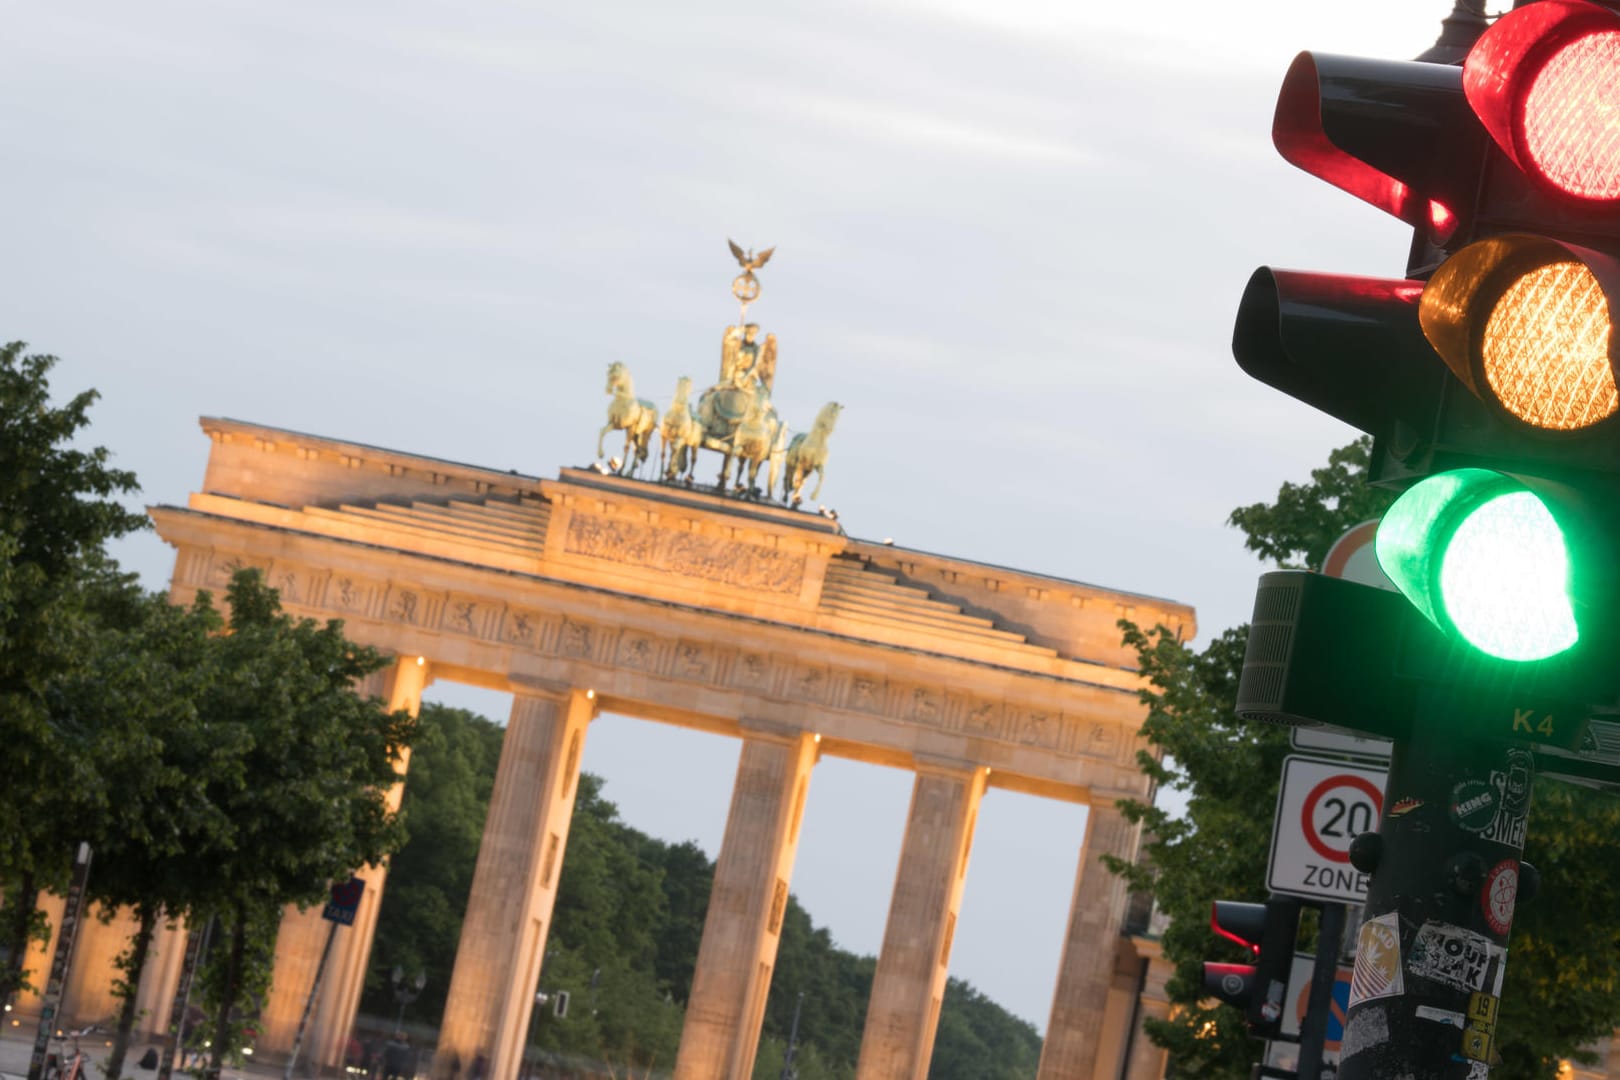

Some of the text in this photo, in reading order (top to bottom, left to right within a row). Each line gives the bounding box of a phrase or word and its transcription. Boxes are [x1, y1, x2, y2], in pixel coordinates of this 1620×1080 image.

[1321, 798, 1372, 838] 20
[1303, 865, 1369, 893] ZONE
[1478, 997, 1494, 1020] 19
